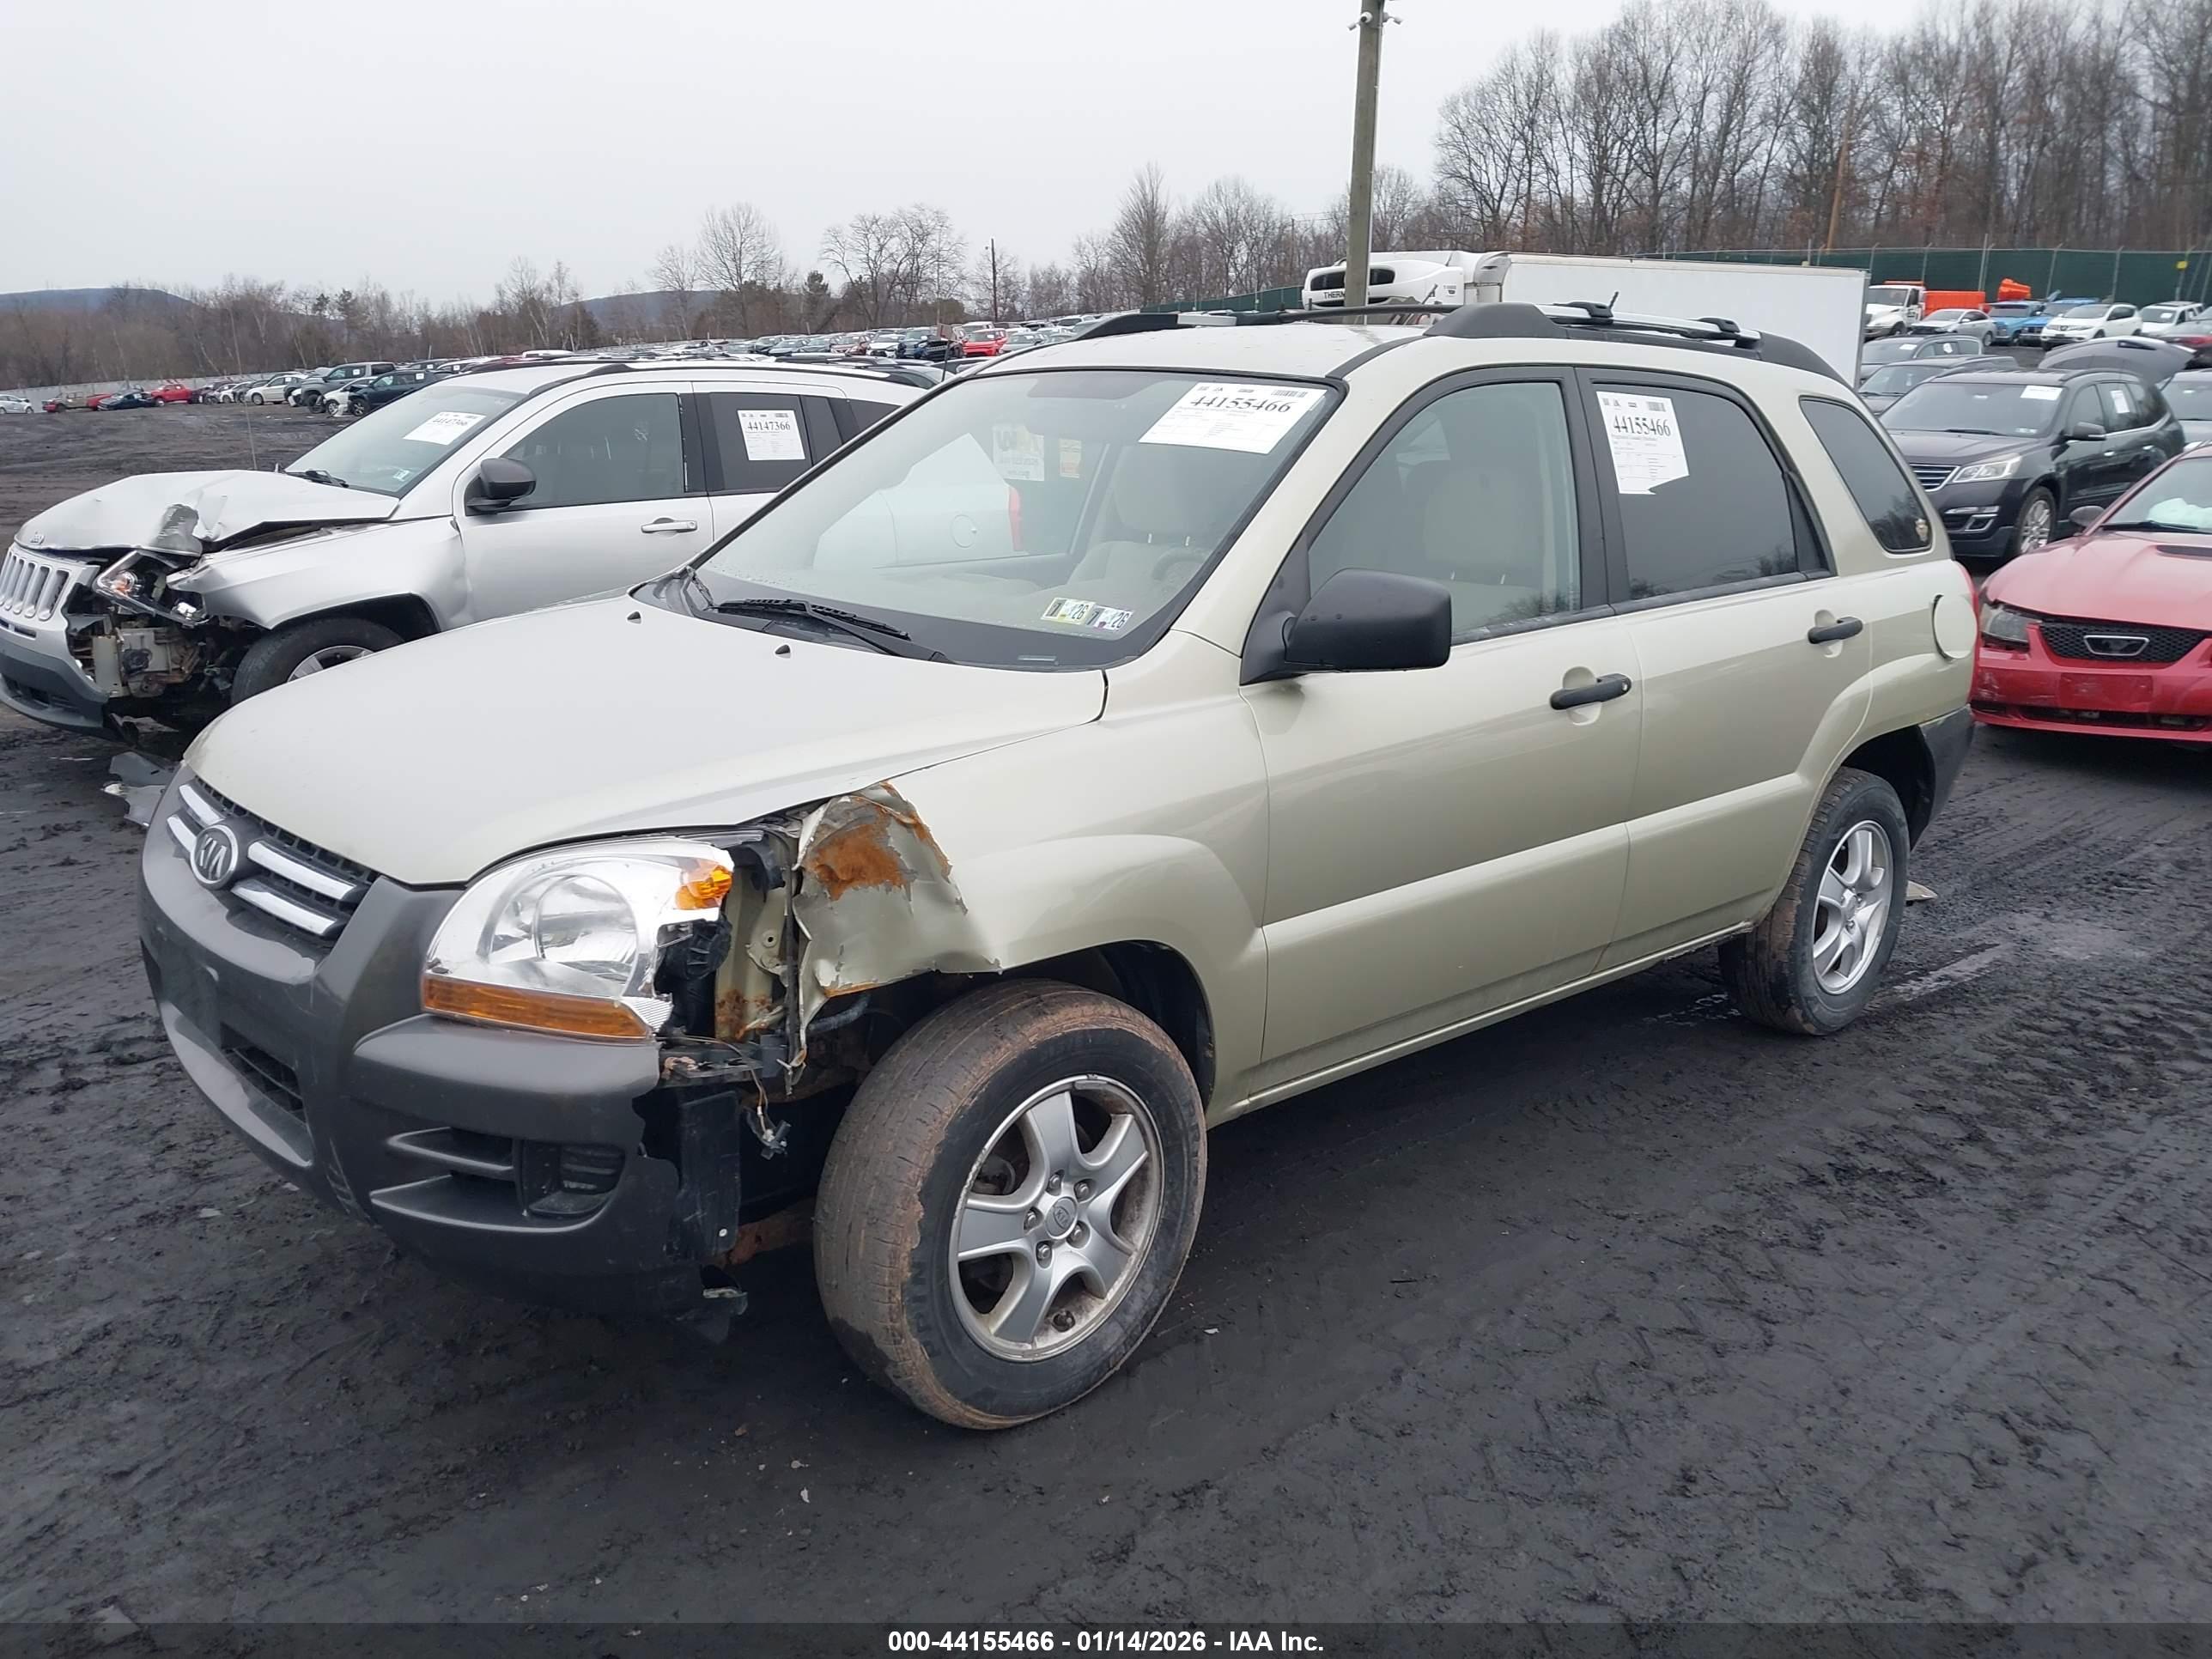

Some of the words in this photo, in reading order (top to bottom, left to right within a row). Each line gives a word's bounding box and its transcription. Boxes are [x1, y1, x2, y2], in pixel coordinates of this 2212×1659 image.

[1323, 290, 1346, 300] THERM
[1190, 395, 1295, 413] 44155466
[747, 421, 791, 431] 44147366
[1613, 414, 1671, 436] 44155466
[1110, 611, 1131, 629] 26
